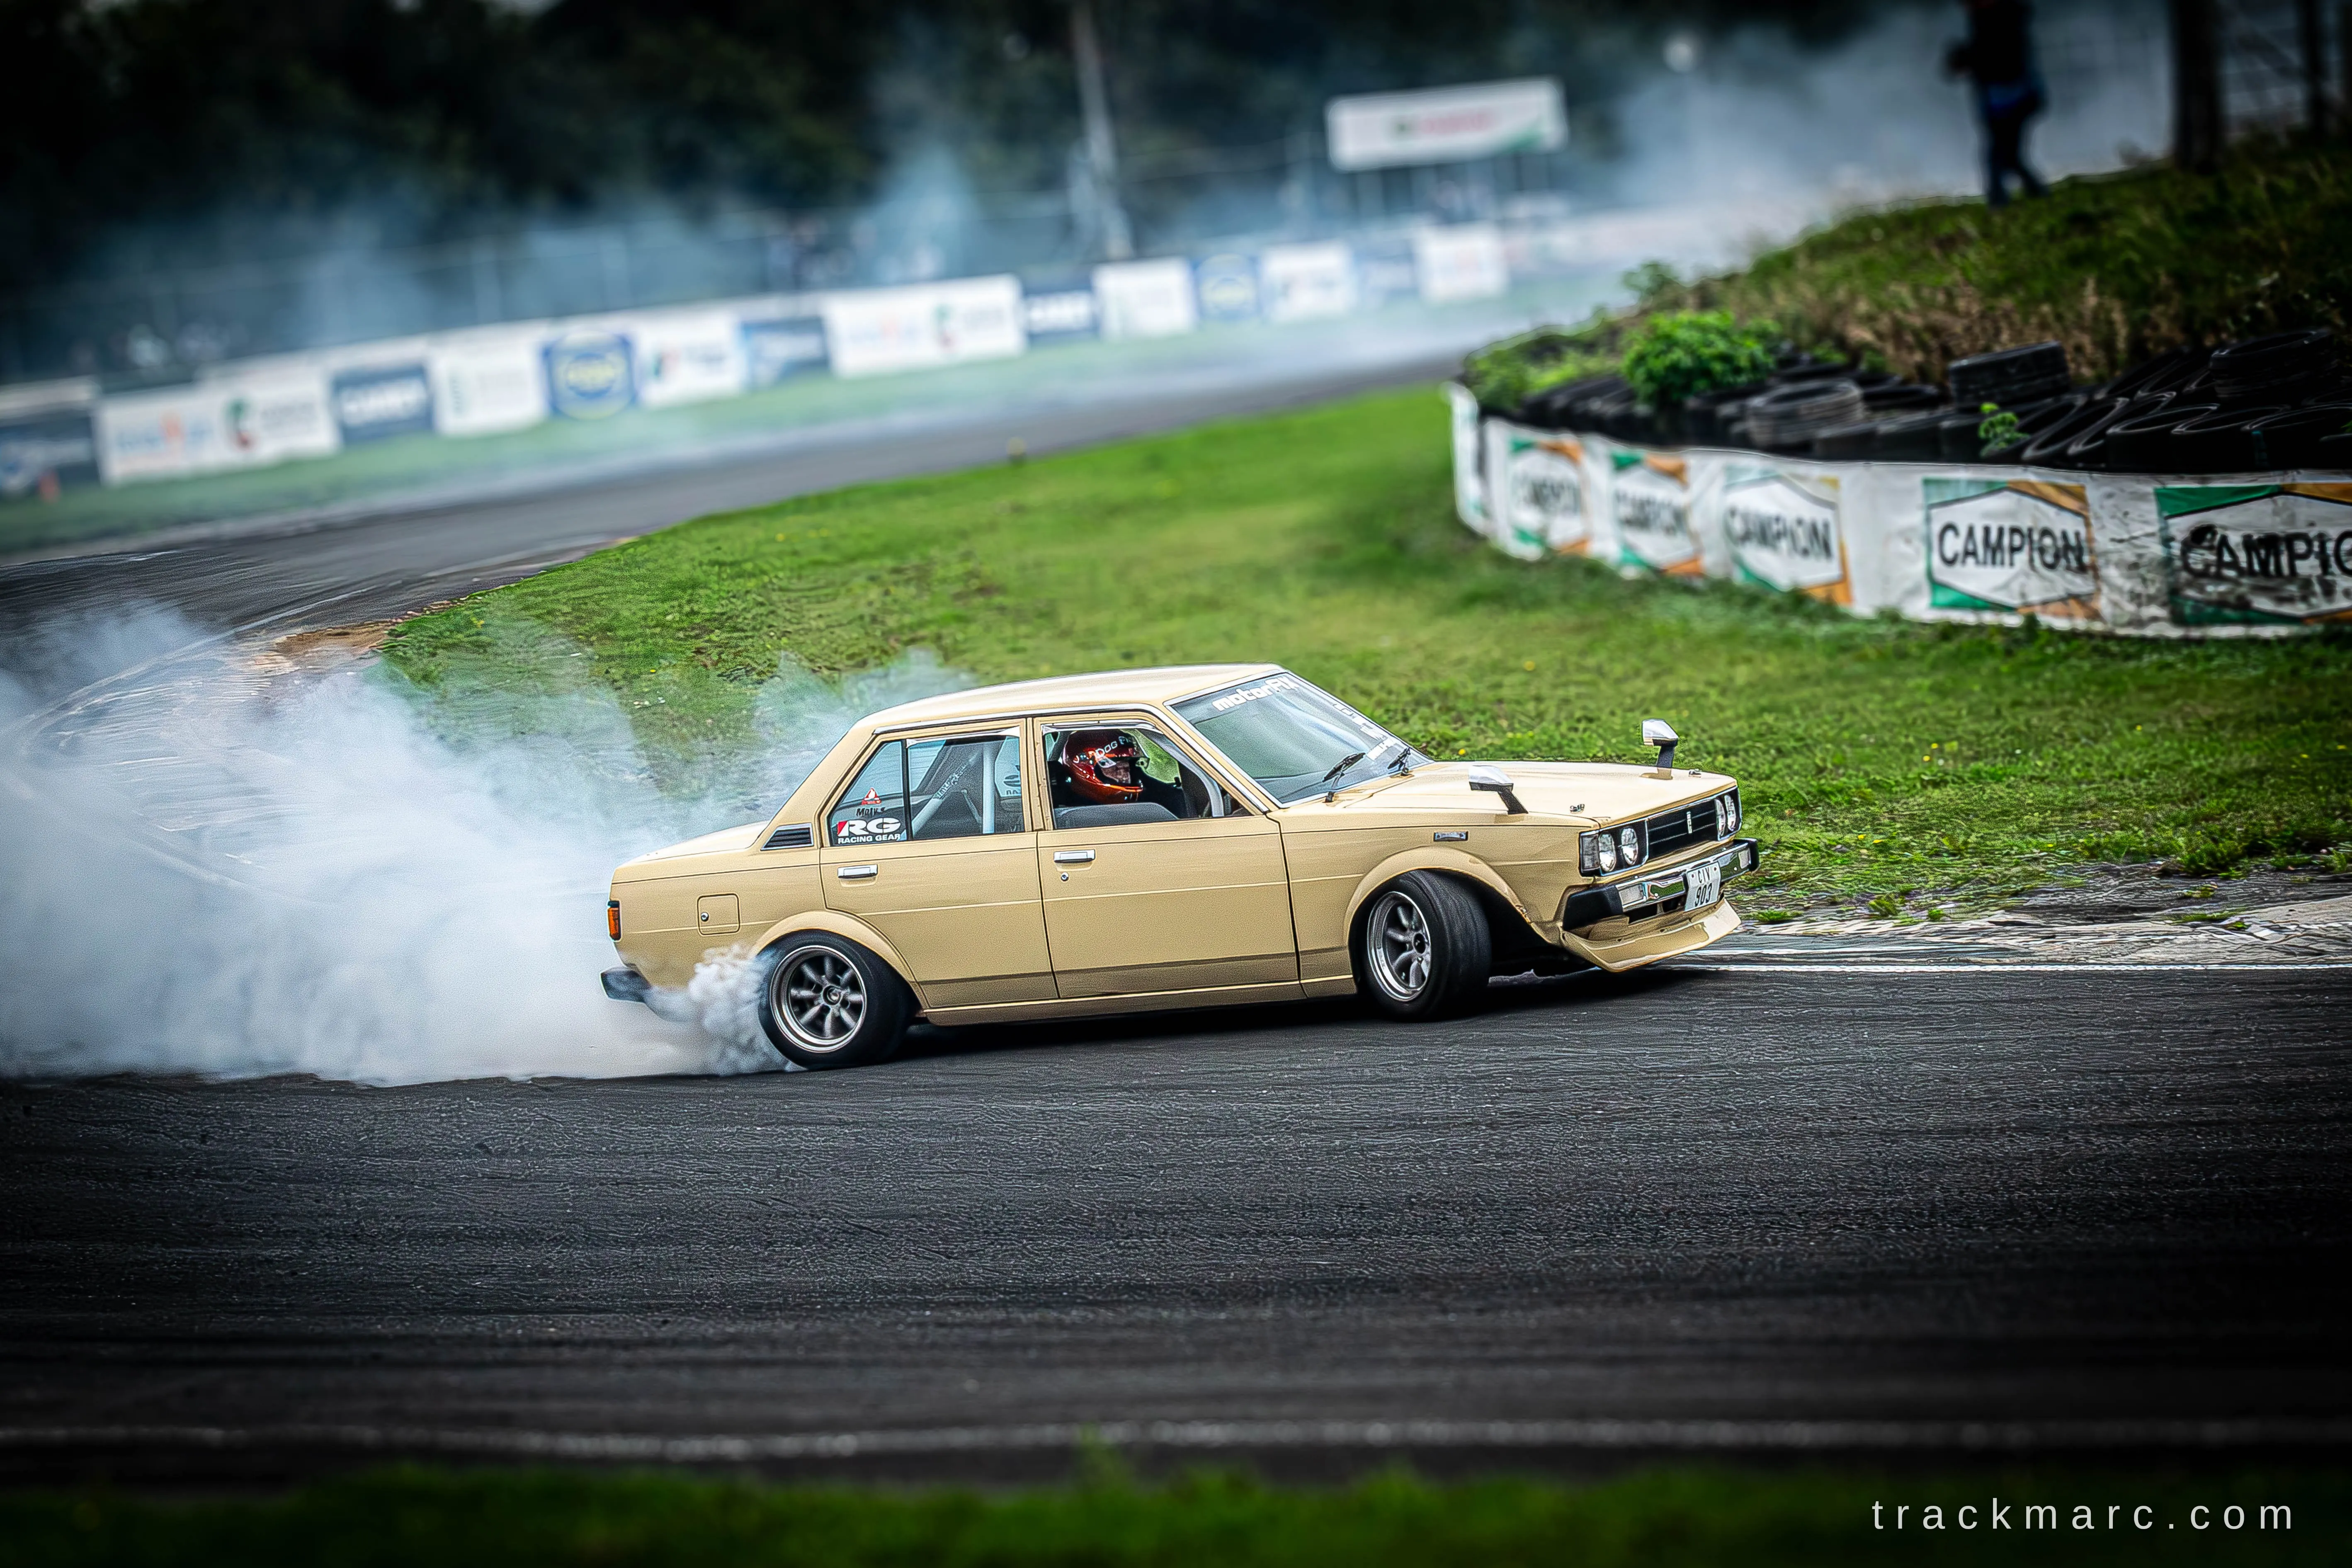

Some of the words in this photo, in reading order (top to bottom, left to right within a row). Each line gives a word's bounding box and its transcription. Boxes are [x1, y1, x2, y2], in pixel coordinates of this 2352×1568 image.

[1723, 505, 1833, 560] CAMPION
[1938, 522, 2088, 574] CAMPION
[837, 817, 901, 837] RG
[837, 836, 873, 844] RACING
[875, 833, 901, 842] GEAR
[1694, 883, 1712, 907] 903
